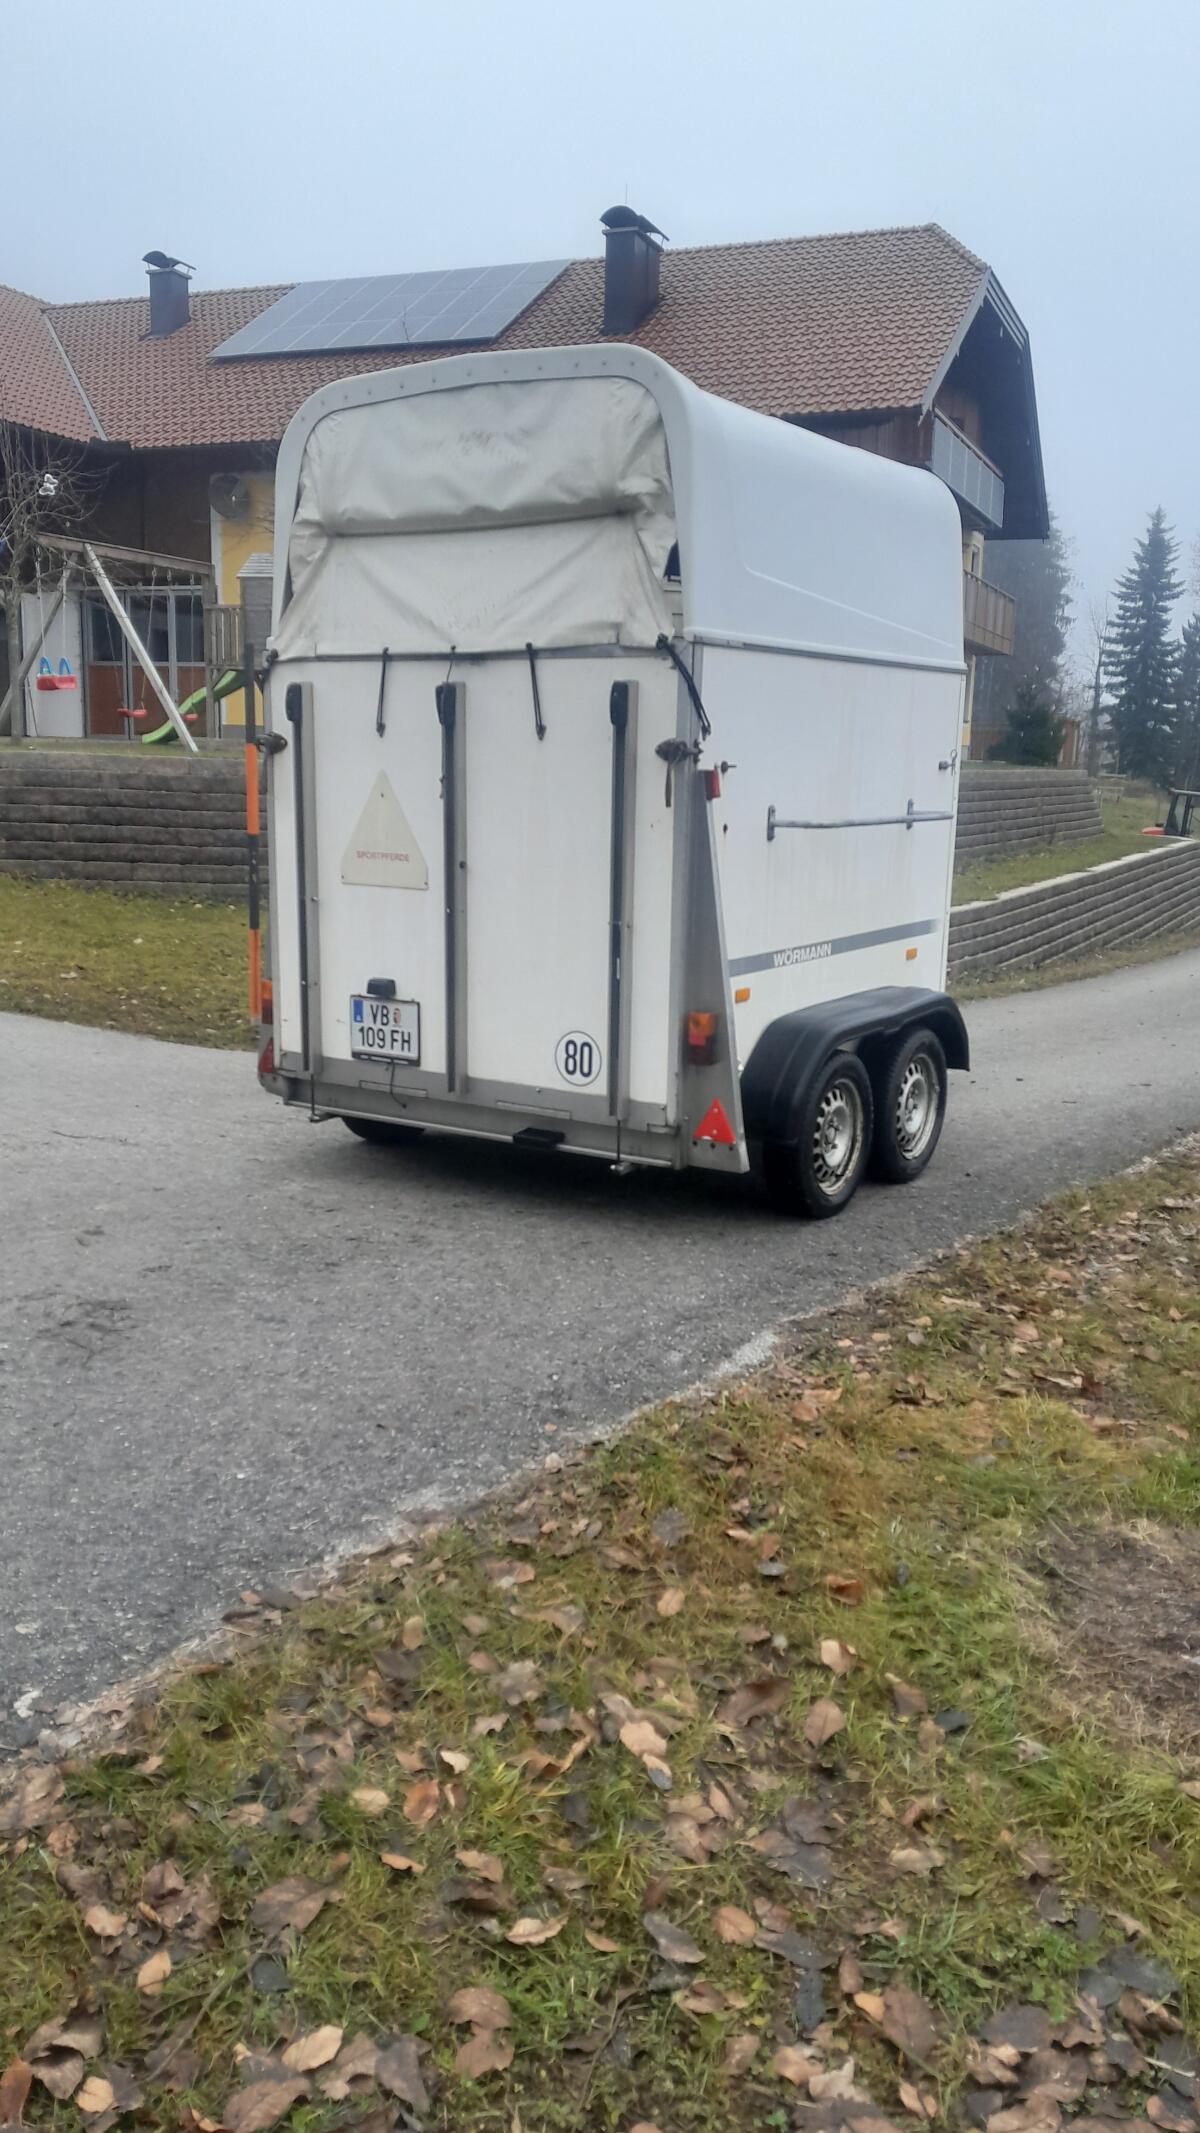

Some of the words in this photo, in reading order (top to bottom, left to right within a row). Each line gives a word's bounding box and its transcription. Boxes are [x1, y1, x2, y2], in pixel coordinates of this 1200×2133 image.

[356, 850, 409, 862] SPORTPFERDE
[773, 941, 832, 968] WÖRMANN
[370, 1004, 390, 1026] VB
[358, 1026, 385, 1049] 109
[390, 1029, 411, 1052] FH
[565, 1039, 592, 1078] 80
